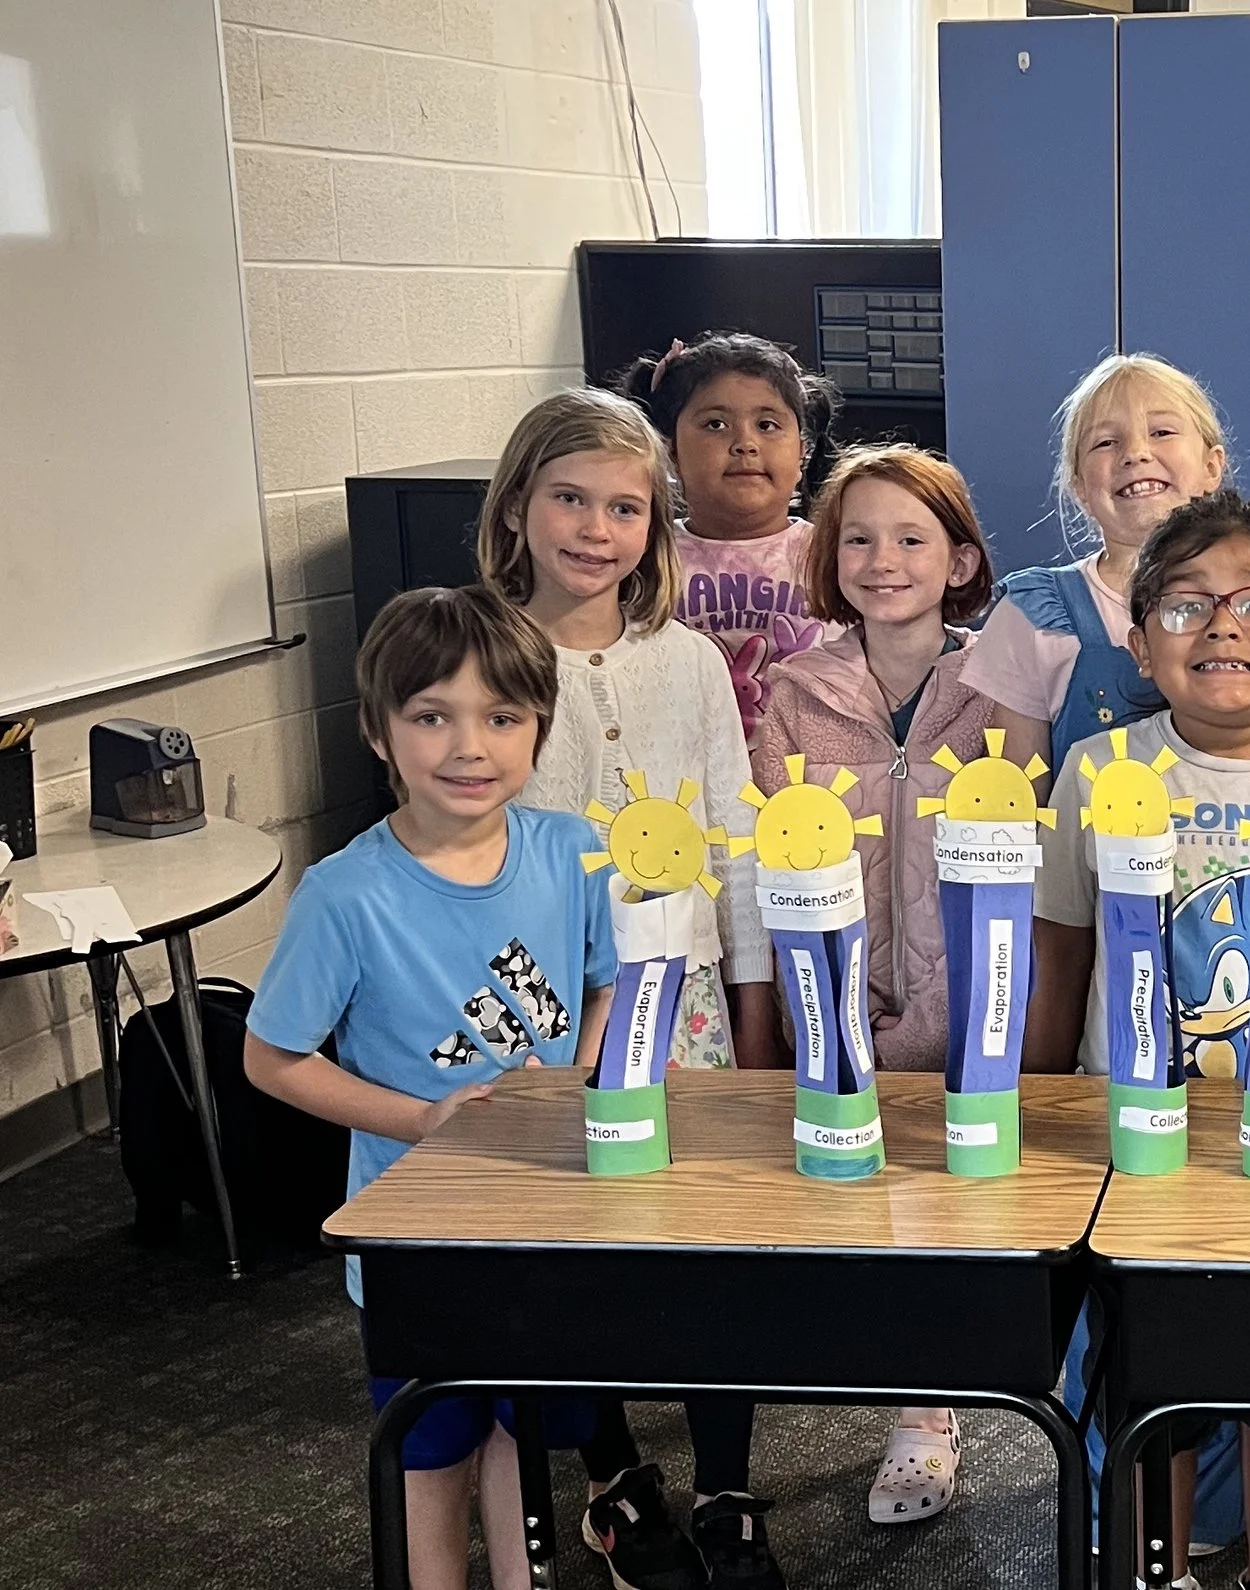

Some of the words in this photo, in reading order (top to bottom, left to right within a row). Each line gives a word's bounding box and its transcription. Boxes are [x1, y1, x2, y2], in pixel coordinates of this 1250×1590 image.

[709, 610, 770, 633] WITH
[769, 887, 855, 907] Condensation
[630, 981, 658, 1068] Evaporation
[799, 967, 822, 1059] Precipitation
[848, 961, 862, 1050] Evaporation
[990, 942, 1009, 1033] Evaporation
[1132, 968, 1151, 1058] Precipitation
[815, 1129, 875, 1146] Collection
